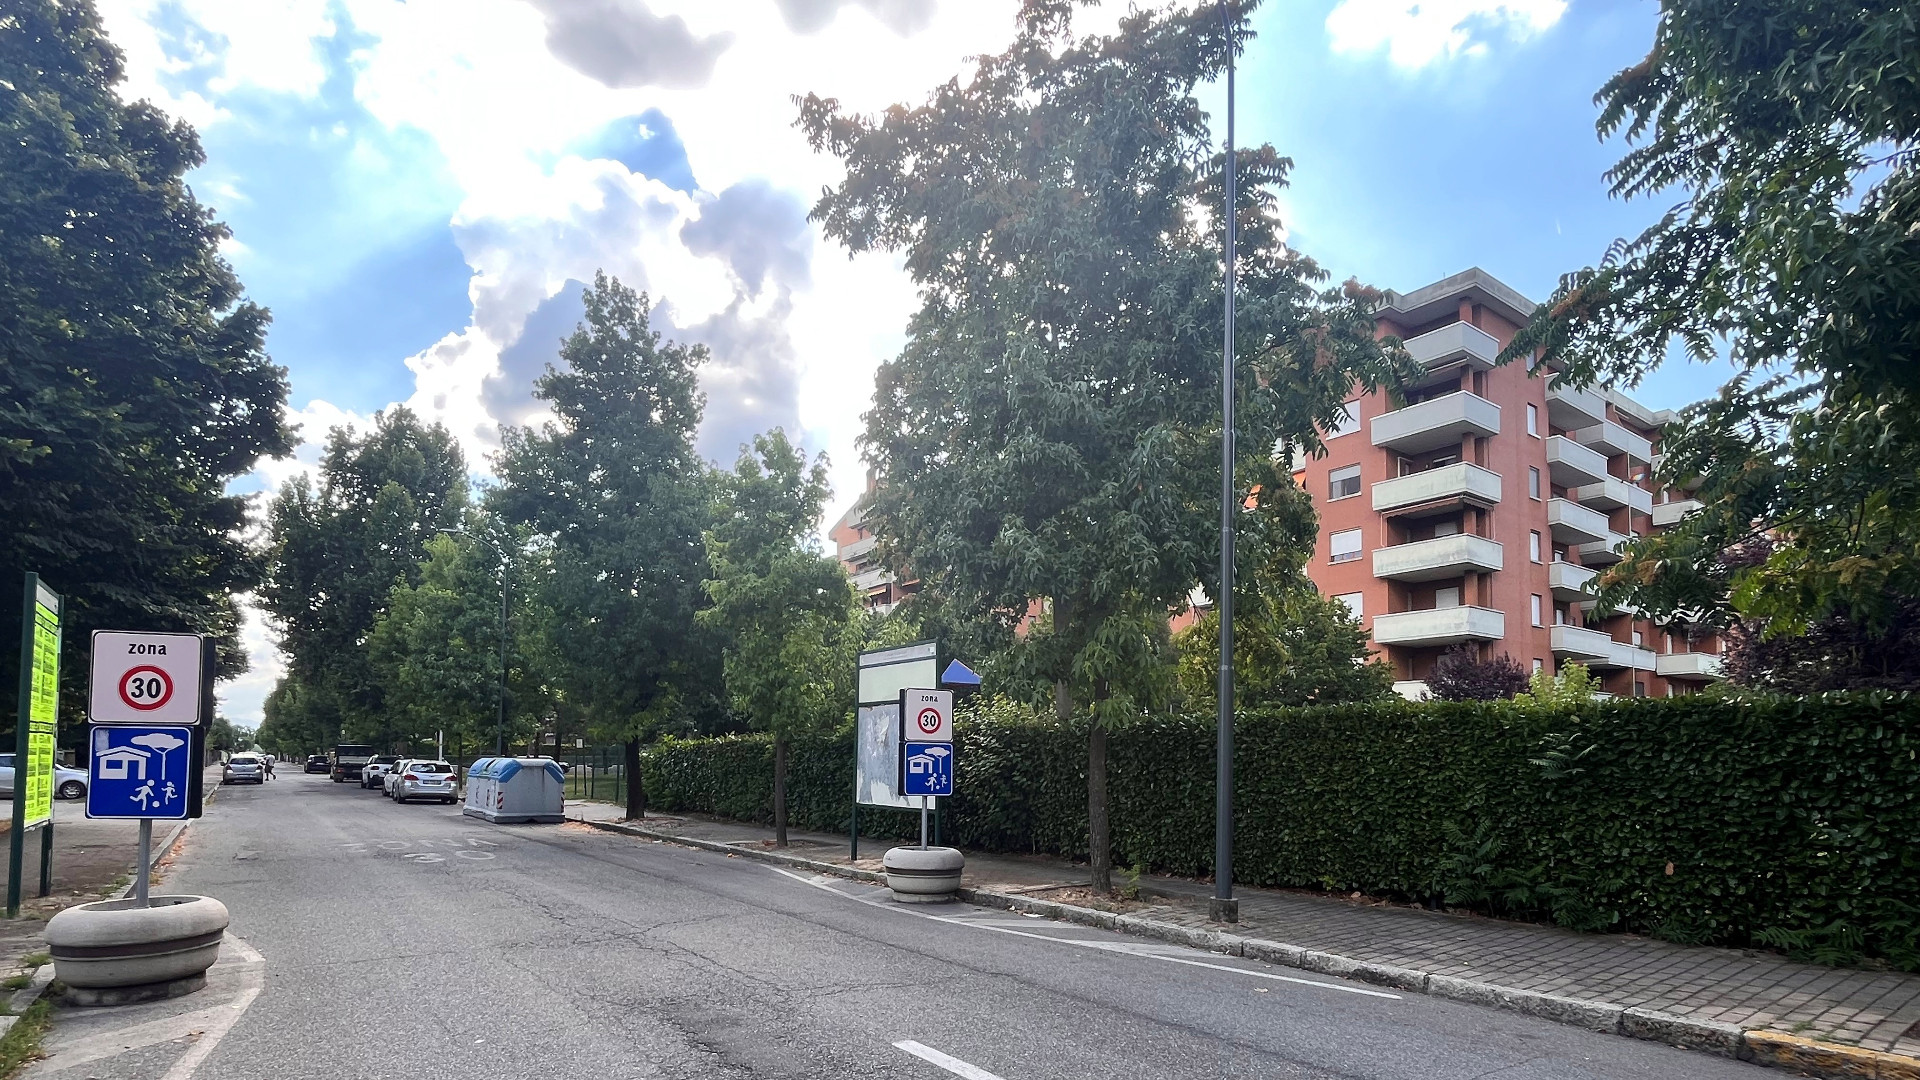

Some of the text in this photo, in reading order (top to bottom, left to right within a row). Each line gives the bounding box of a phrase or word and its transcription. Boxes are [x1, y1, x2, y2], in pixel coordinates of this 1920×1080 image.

[128, 643, 167, 656] zona
[131, 678, 161, 698] 30
[923, 715, 936, 727] 30
